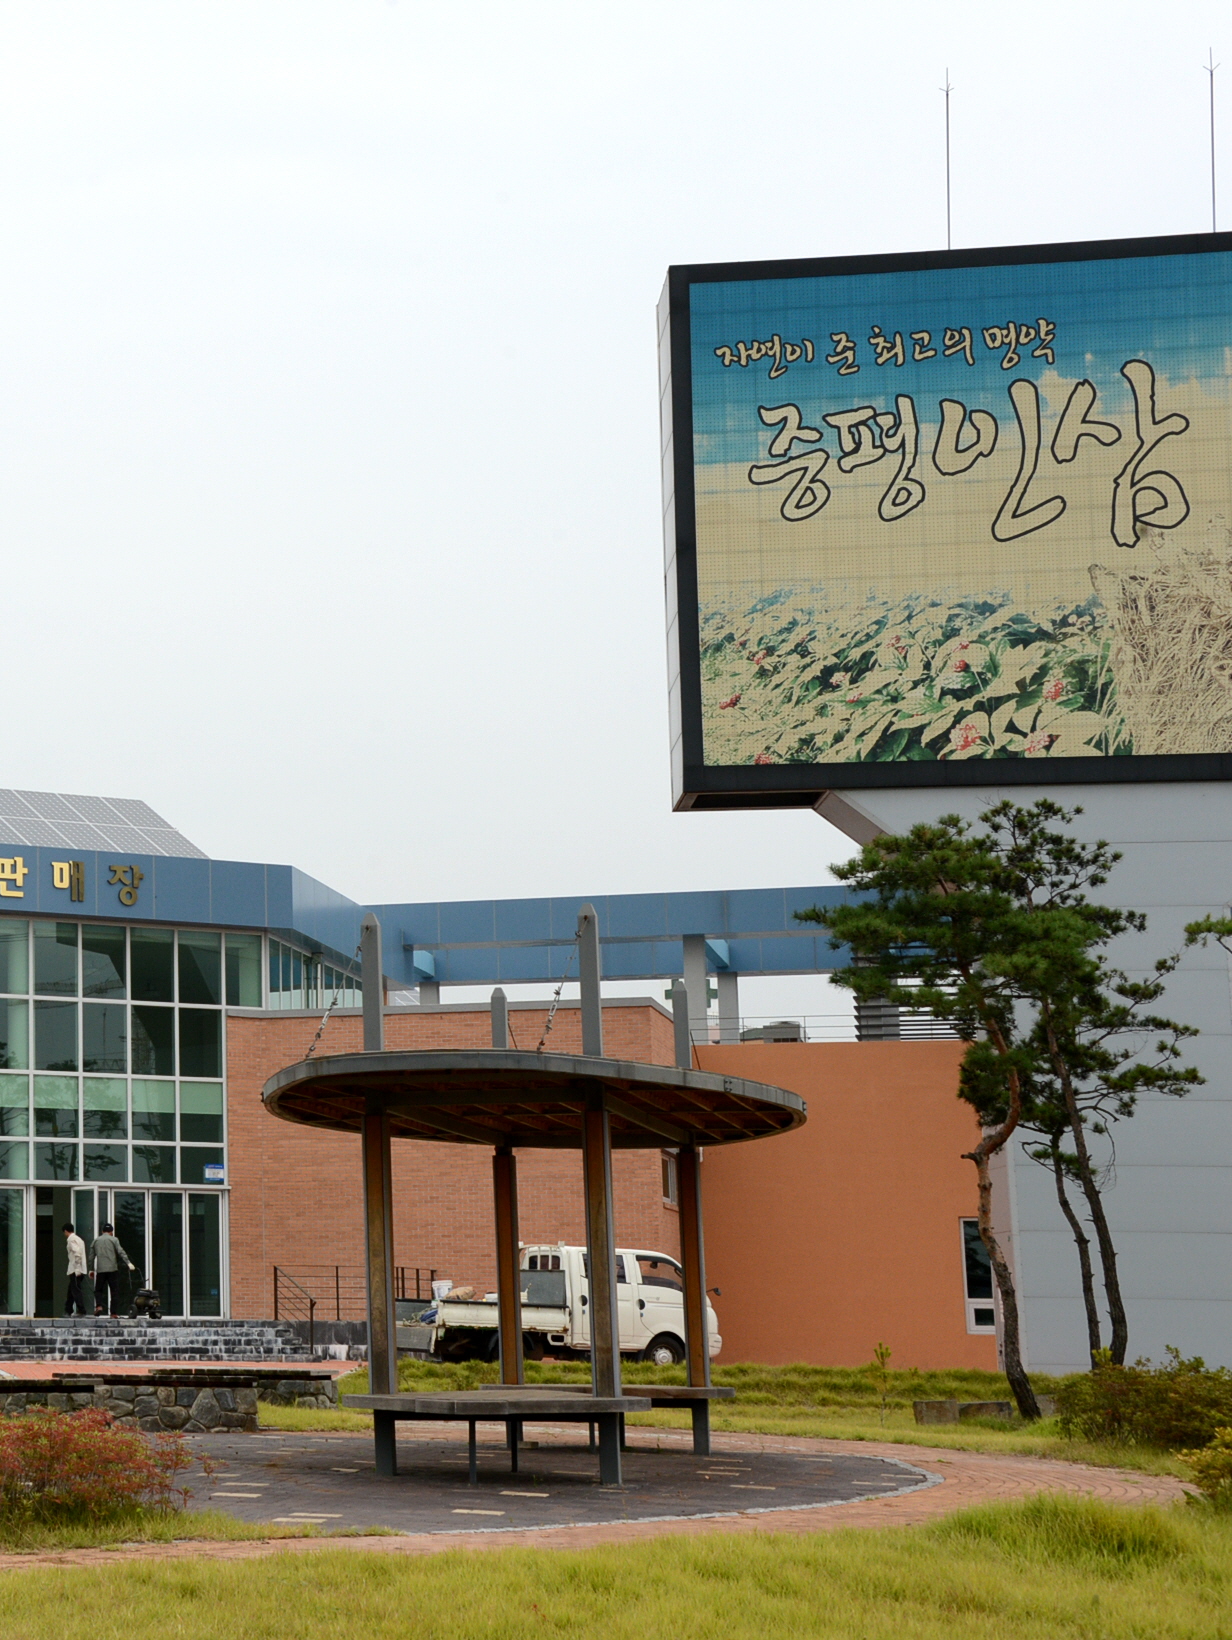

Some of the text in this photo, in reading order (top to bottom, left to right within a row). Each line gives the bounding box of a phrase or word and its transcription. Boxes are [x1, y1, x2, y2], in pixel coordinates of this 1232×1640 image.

[714, 317, 1056, 379] 자연이 준 최고의 명약
[748, 358, 1191, 549] 증평인삼
